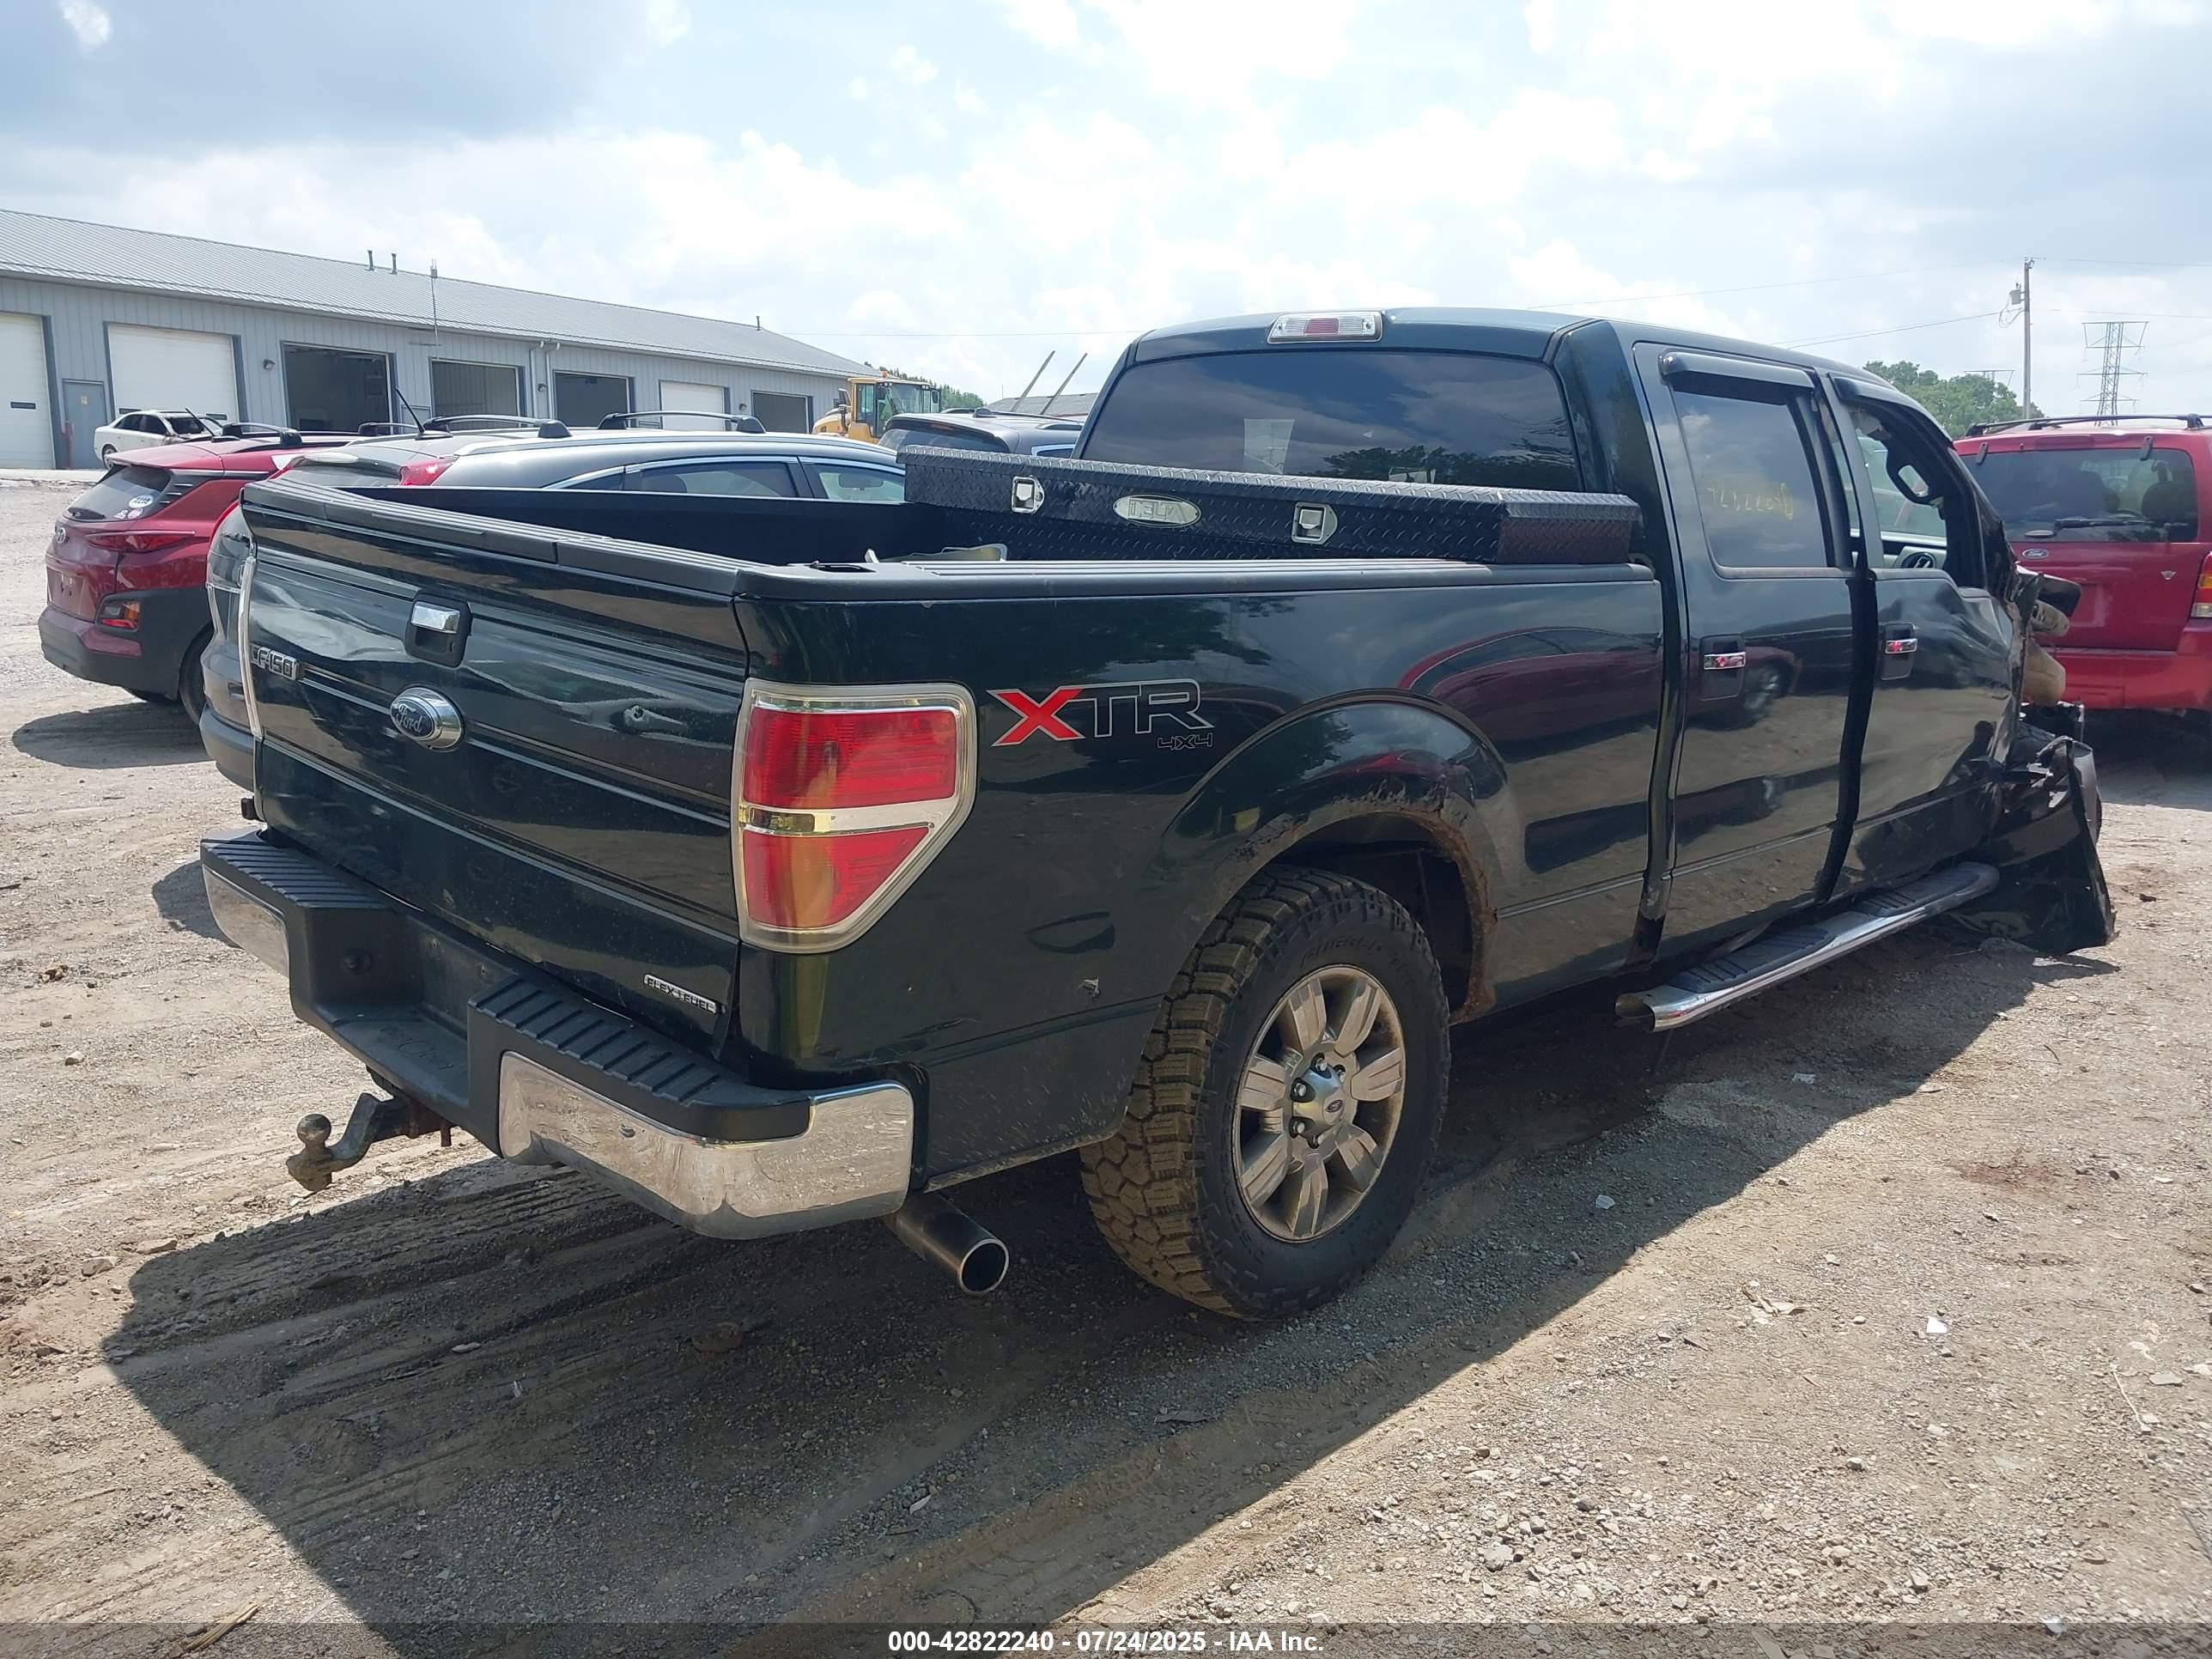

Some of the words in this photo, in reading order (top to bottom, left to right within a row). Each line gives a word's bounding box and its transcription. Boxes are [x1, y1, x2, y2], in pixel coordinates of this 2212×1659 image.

[1128, 498, 1187, 523] DELTA
[395, 703, 424, 732] Ford
[986, 679, 1215, 746] XTR
[646, 976, 674, 996] FLEX
[684, 994, 715, 1013] FUEL
